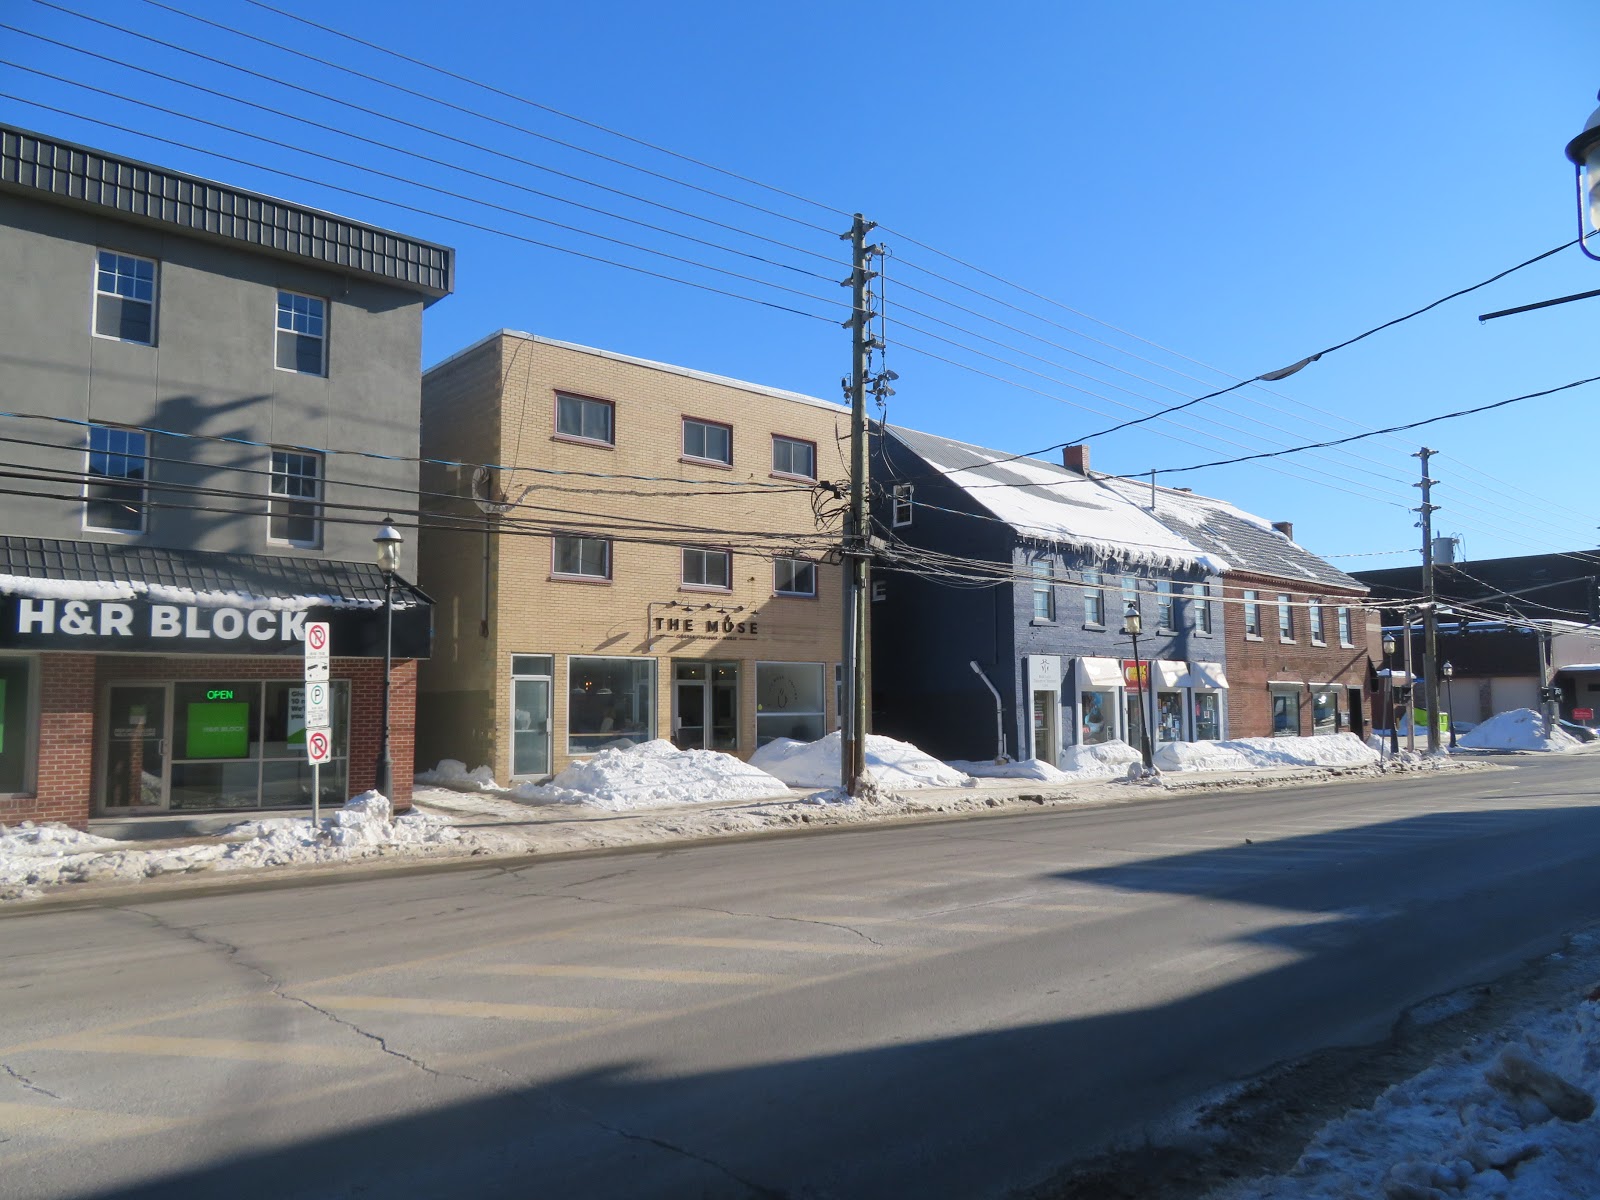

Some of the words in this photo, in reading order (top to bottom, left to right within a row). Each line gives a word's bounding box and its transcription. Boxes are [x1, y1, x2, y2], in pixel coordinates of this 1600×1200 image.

[18, 599, 134, 636] H&R
[151, 605, 307, 641] BLOCK
[655, 618, 694, 631] THE
[706, 616, 758, 634] MUSE
[206, 690, 233, 699] OPEN
